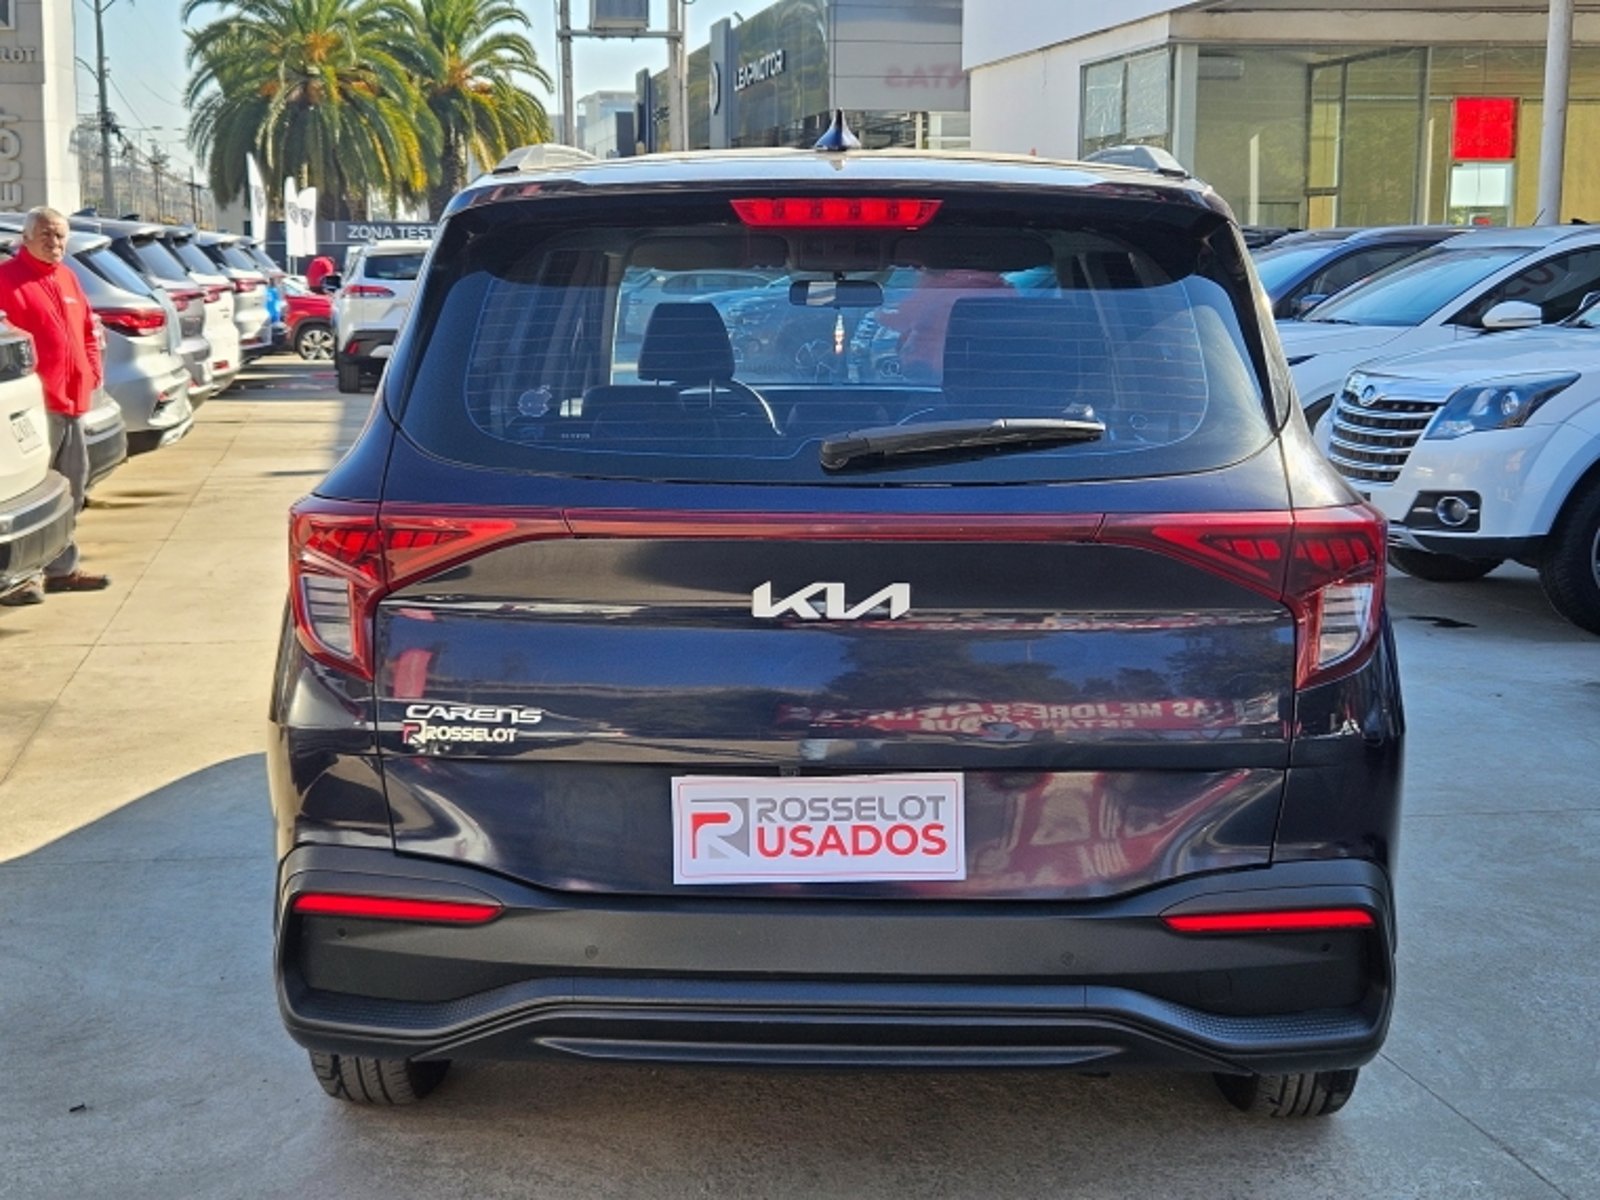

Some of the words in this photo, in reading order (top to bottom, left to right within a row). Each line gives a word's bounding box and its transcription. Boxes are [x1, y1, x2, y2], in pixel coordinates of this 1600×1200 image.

[347, 225, 395, 240] ZONA
[752, 581, 910, 620] KIA
[406, 703, 543, 725] CARENS
[755, 795, 946, 823] ROSSELOT
[756, 823, 948, 858] USADOS
